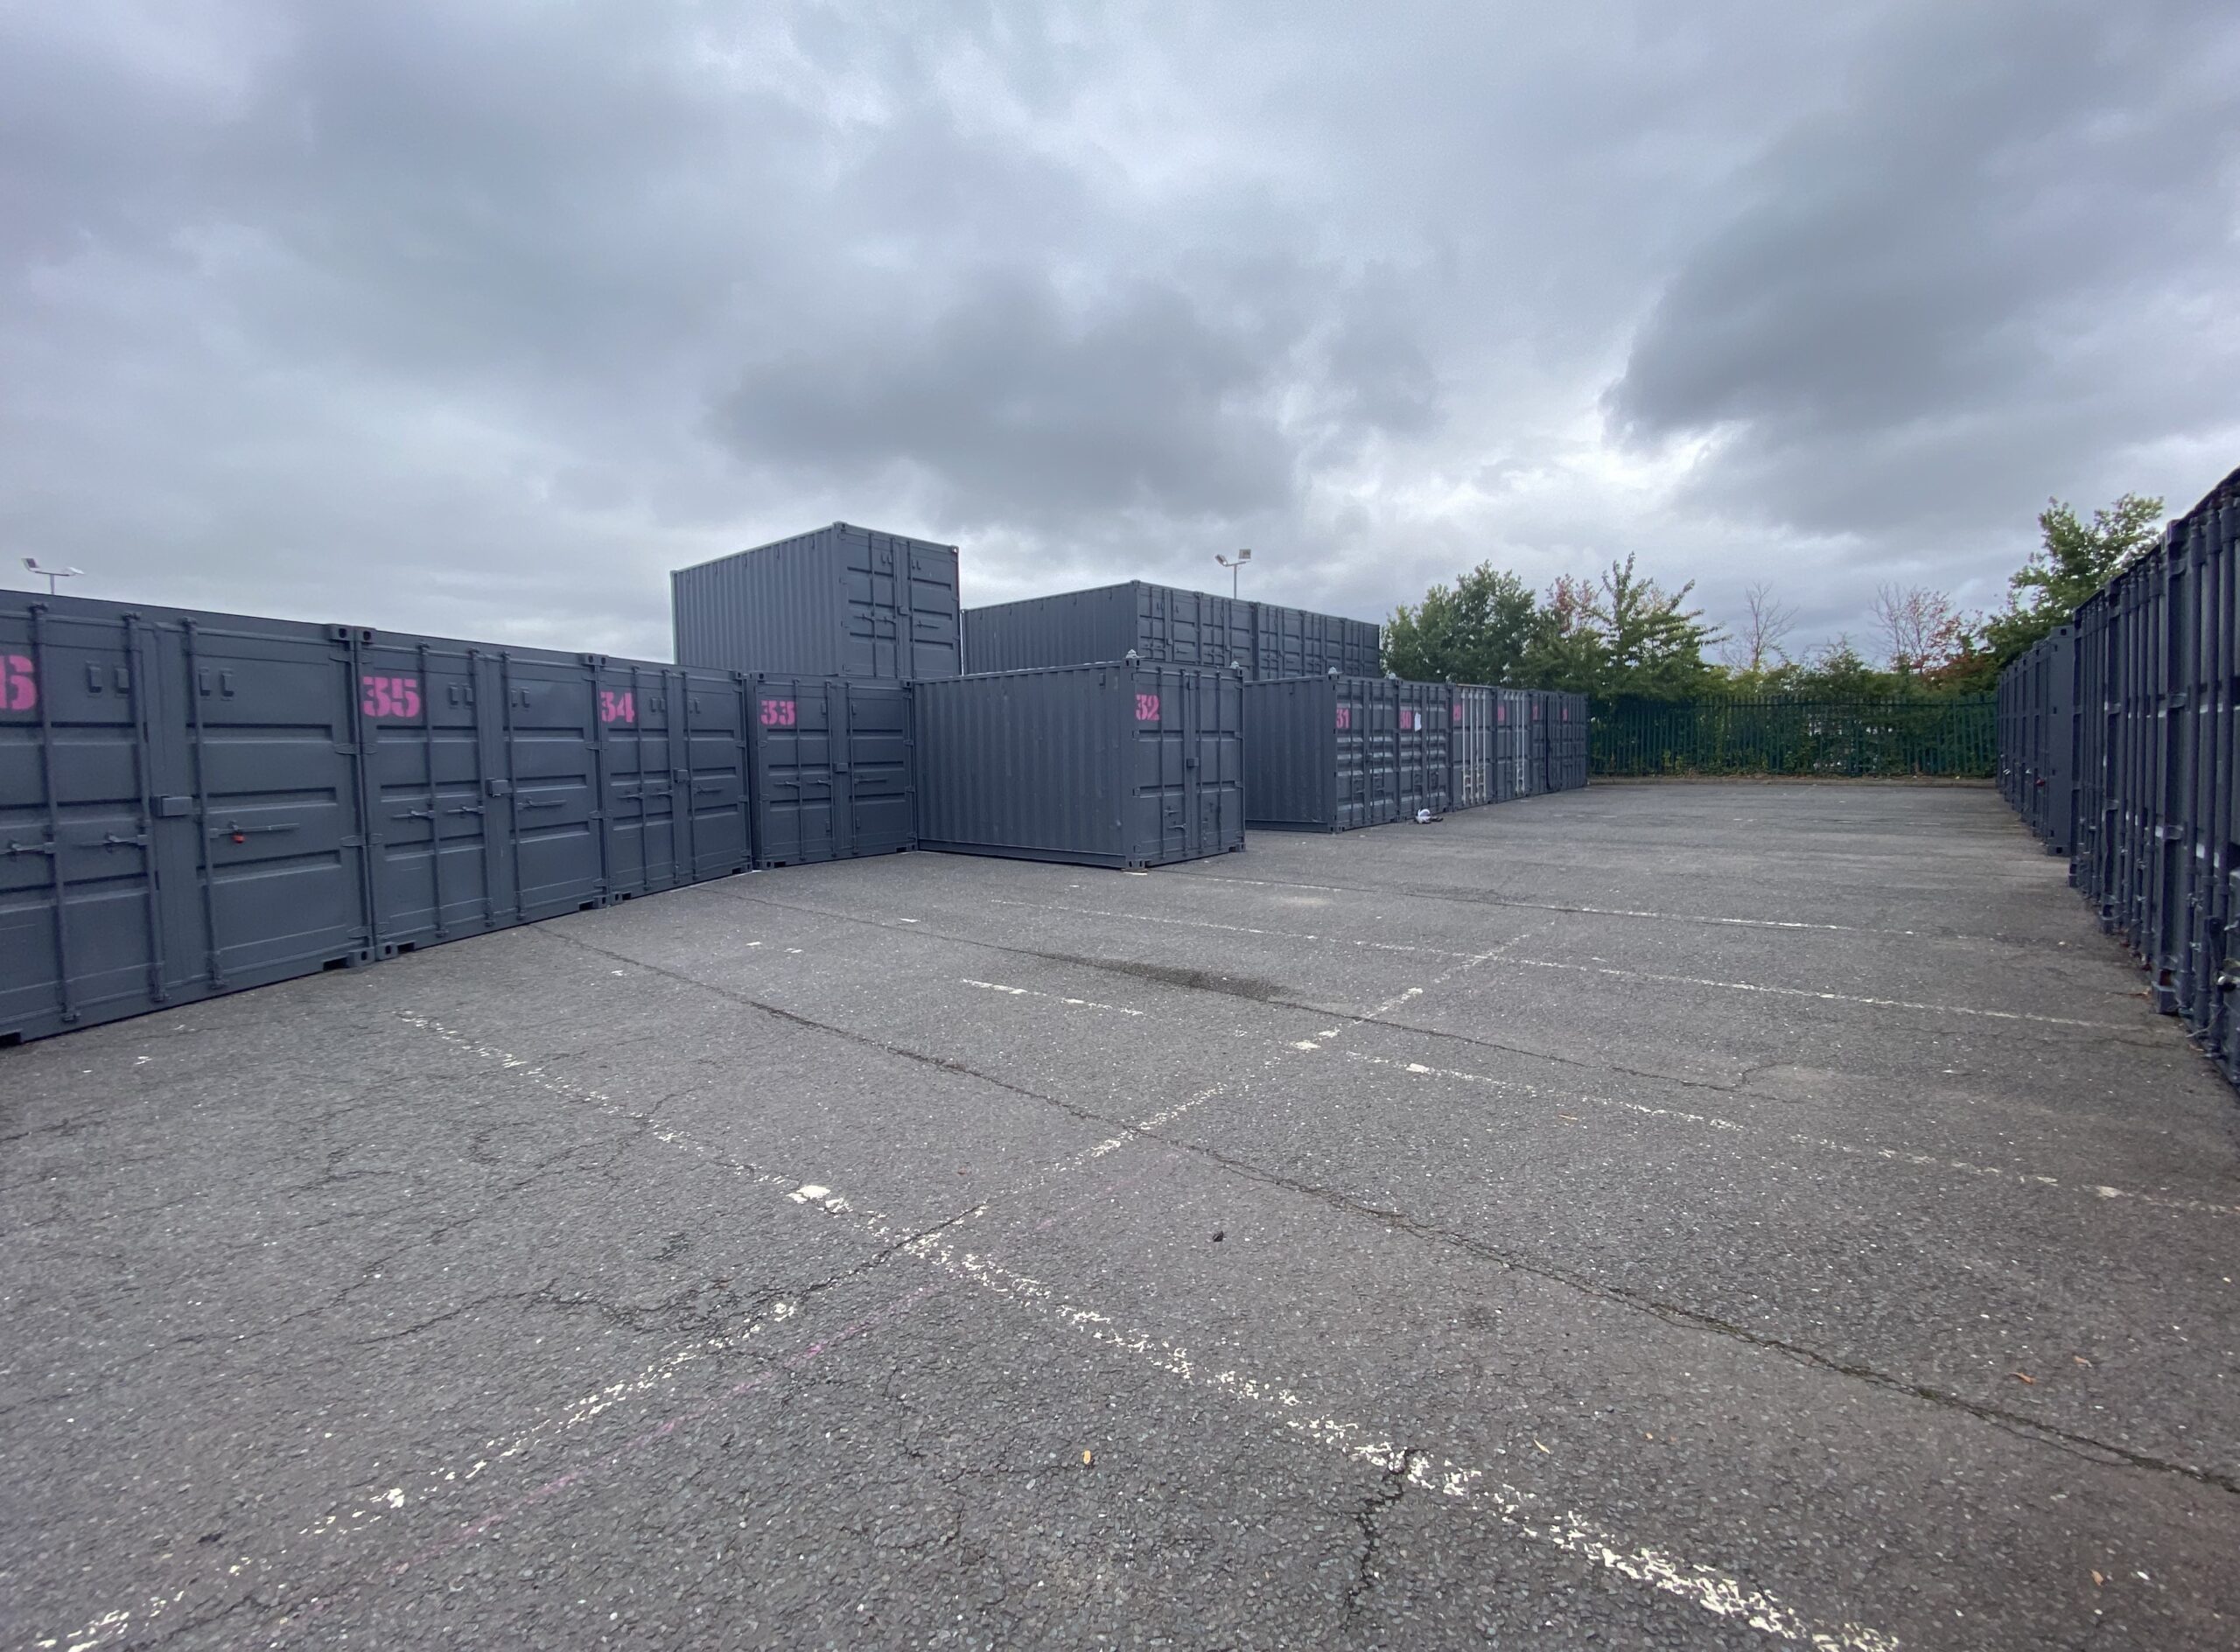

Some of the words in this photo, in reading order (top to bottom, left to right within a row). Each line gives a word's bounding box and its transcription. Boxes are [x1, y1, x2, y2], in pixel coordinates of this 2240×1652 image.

[363, 676, 420, 718] 35
[601, 692, 635, 723] 34
[1135, 694, 1160, 721] 32
[761, 700, 796, 725] 33
[1336, 708, 1350, 728] 31
